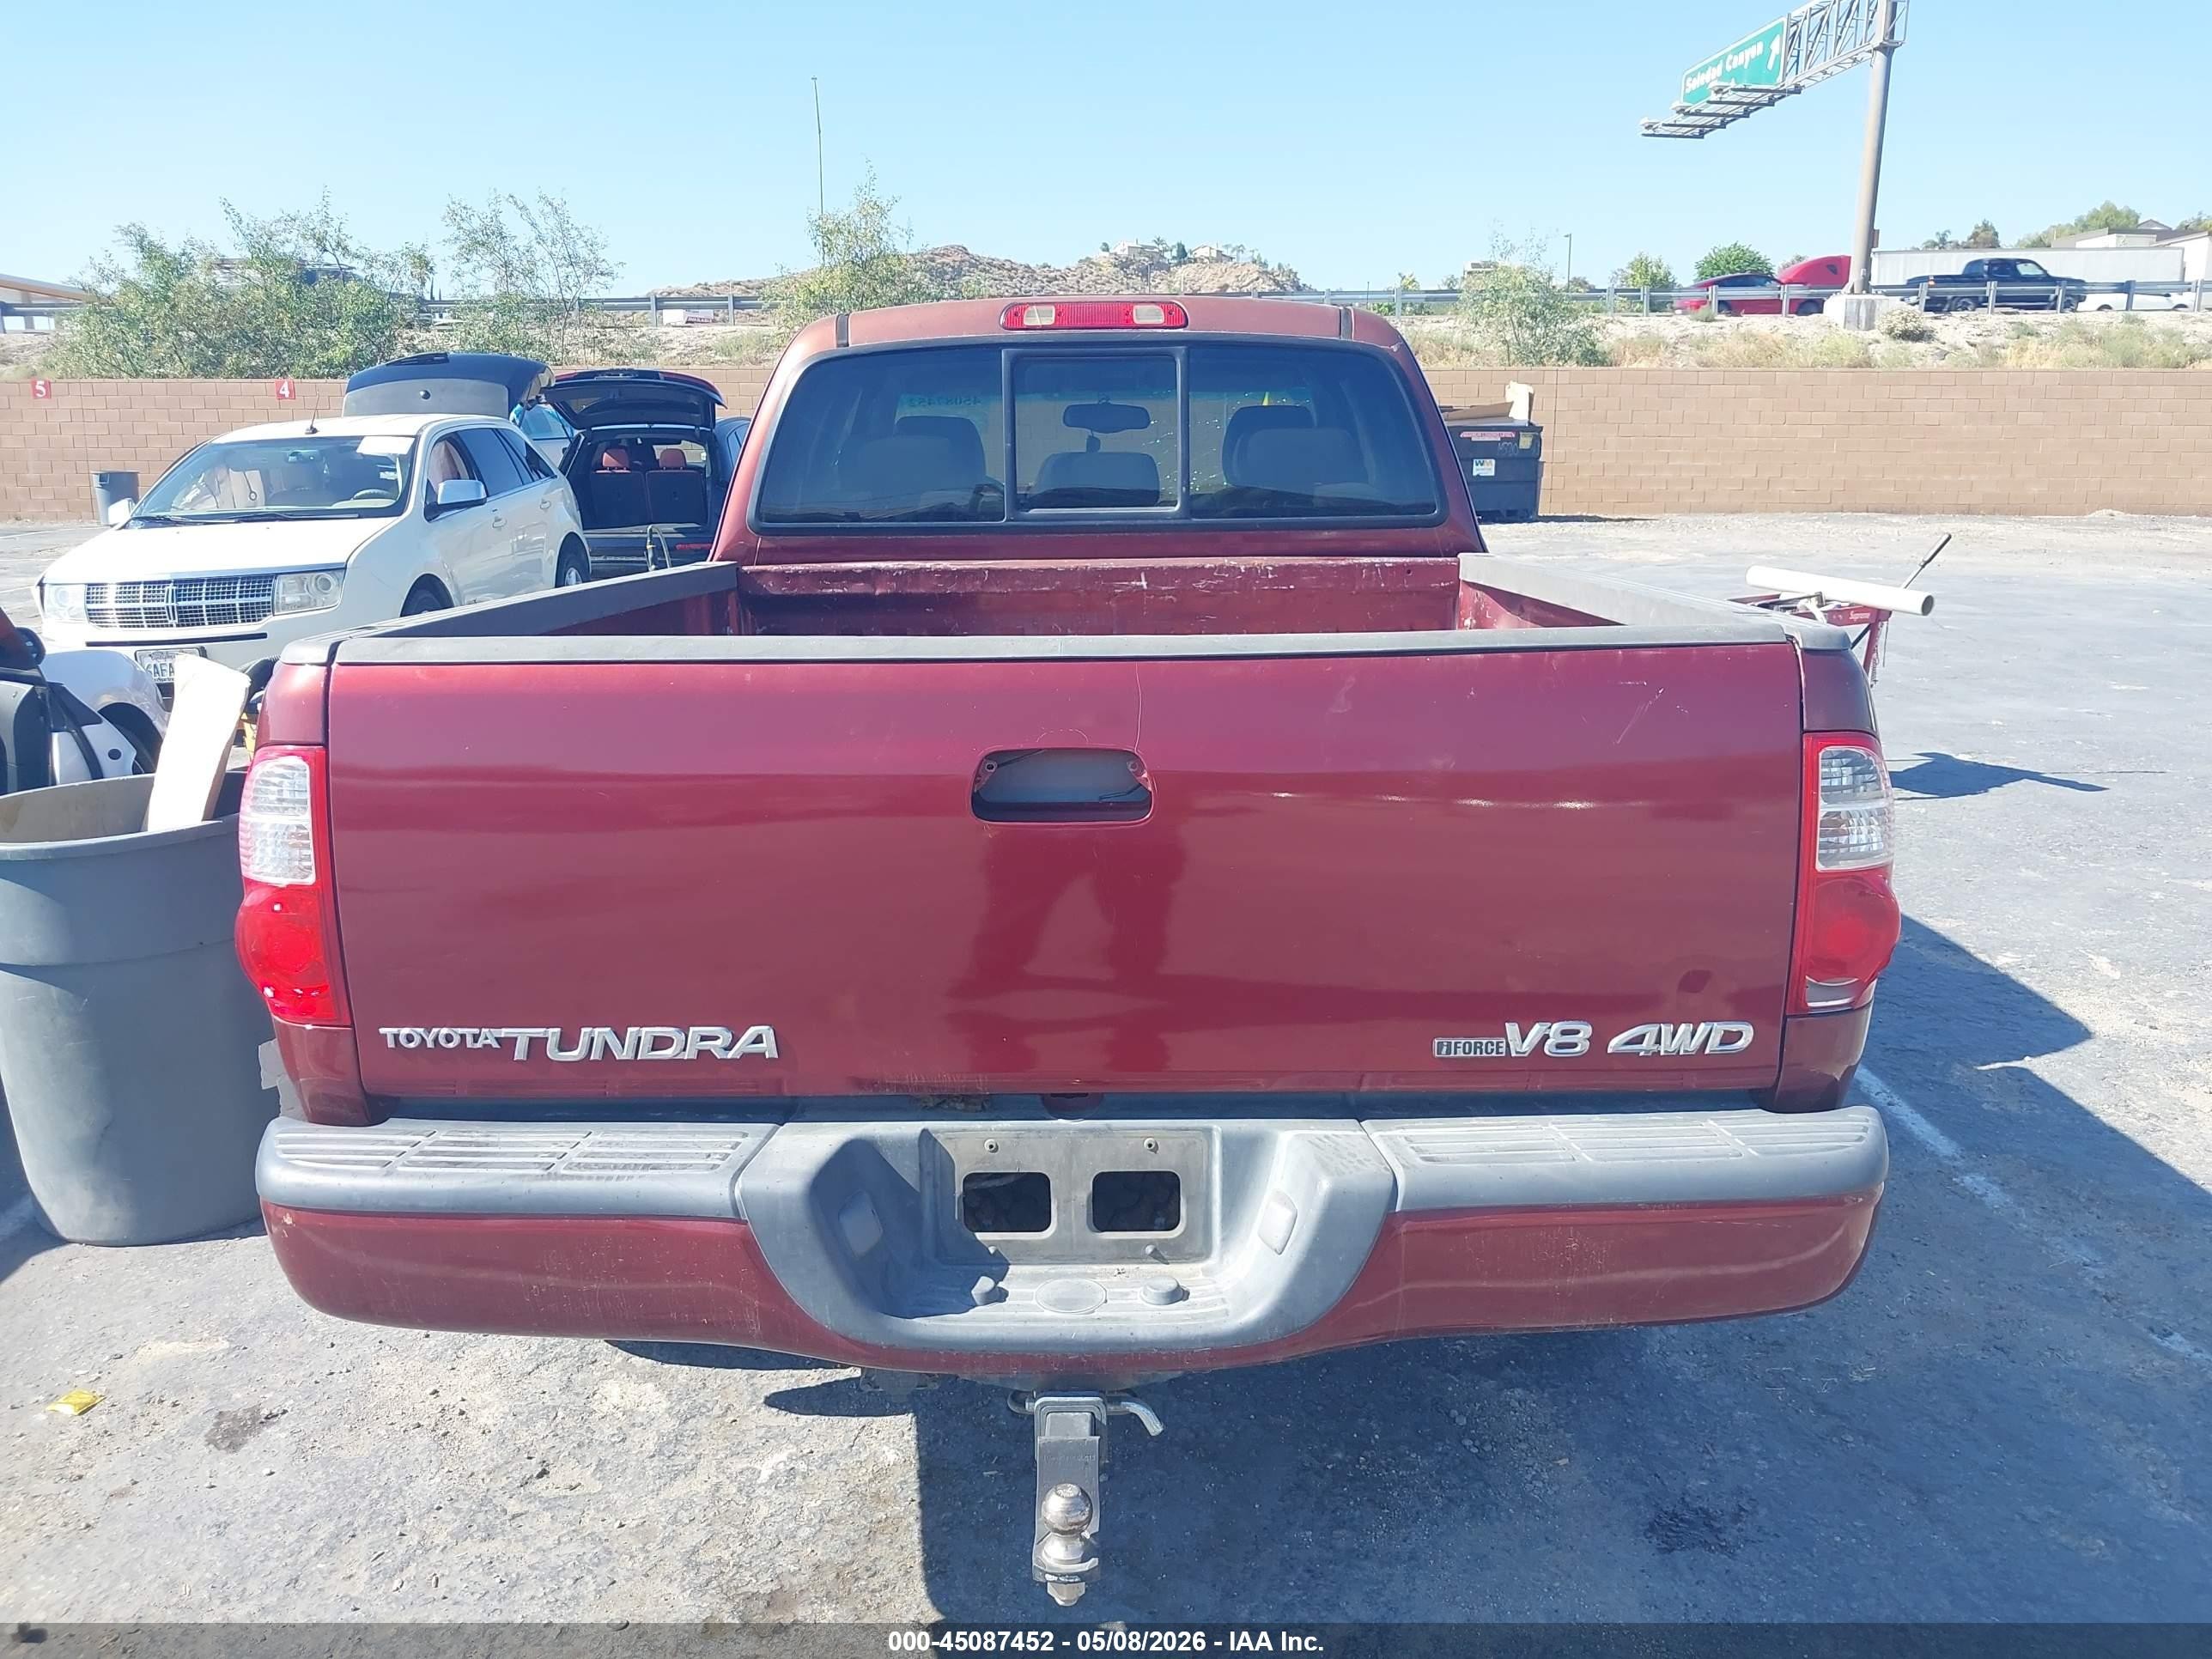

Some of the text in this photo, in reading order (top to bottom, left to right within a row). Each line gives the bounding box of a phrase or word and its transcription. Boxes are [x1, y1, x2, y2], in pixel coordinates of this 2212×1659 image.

[1686, 40, 1764, 94] Soledad Canyon
[35, 380, 46, 398] 5
[278, 380, 290, 398] 4
[379, 1025, 779, 1061] TOYOTA TUNDRA
[1505, 1021, 1592, 1057] V8
[1607, 1021, 1753, 1057] 4WD
